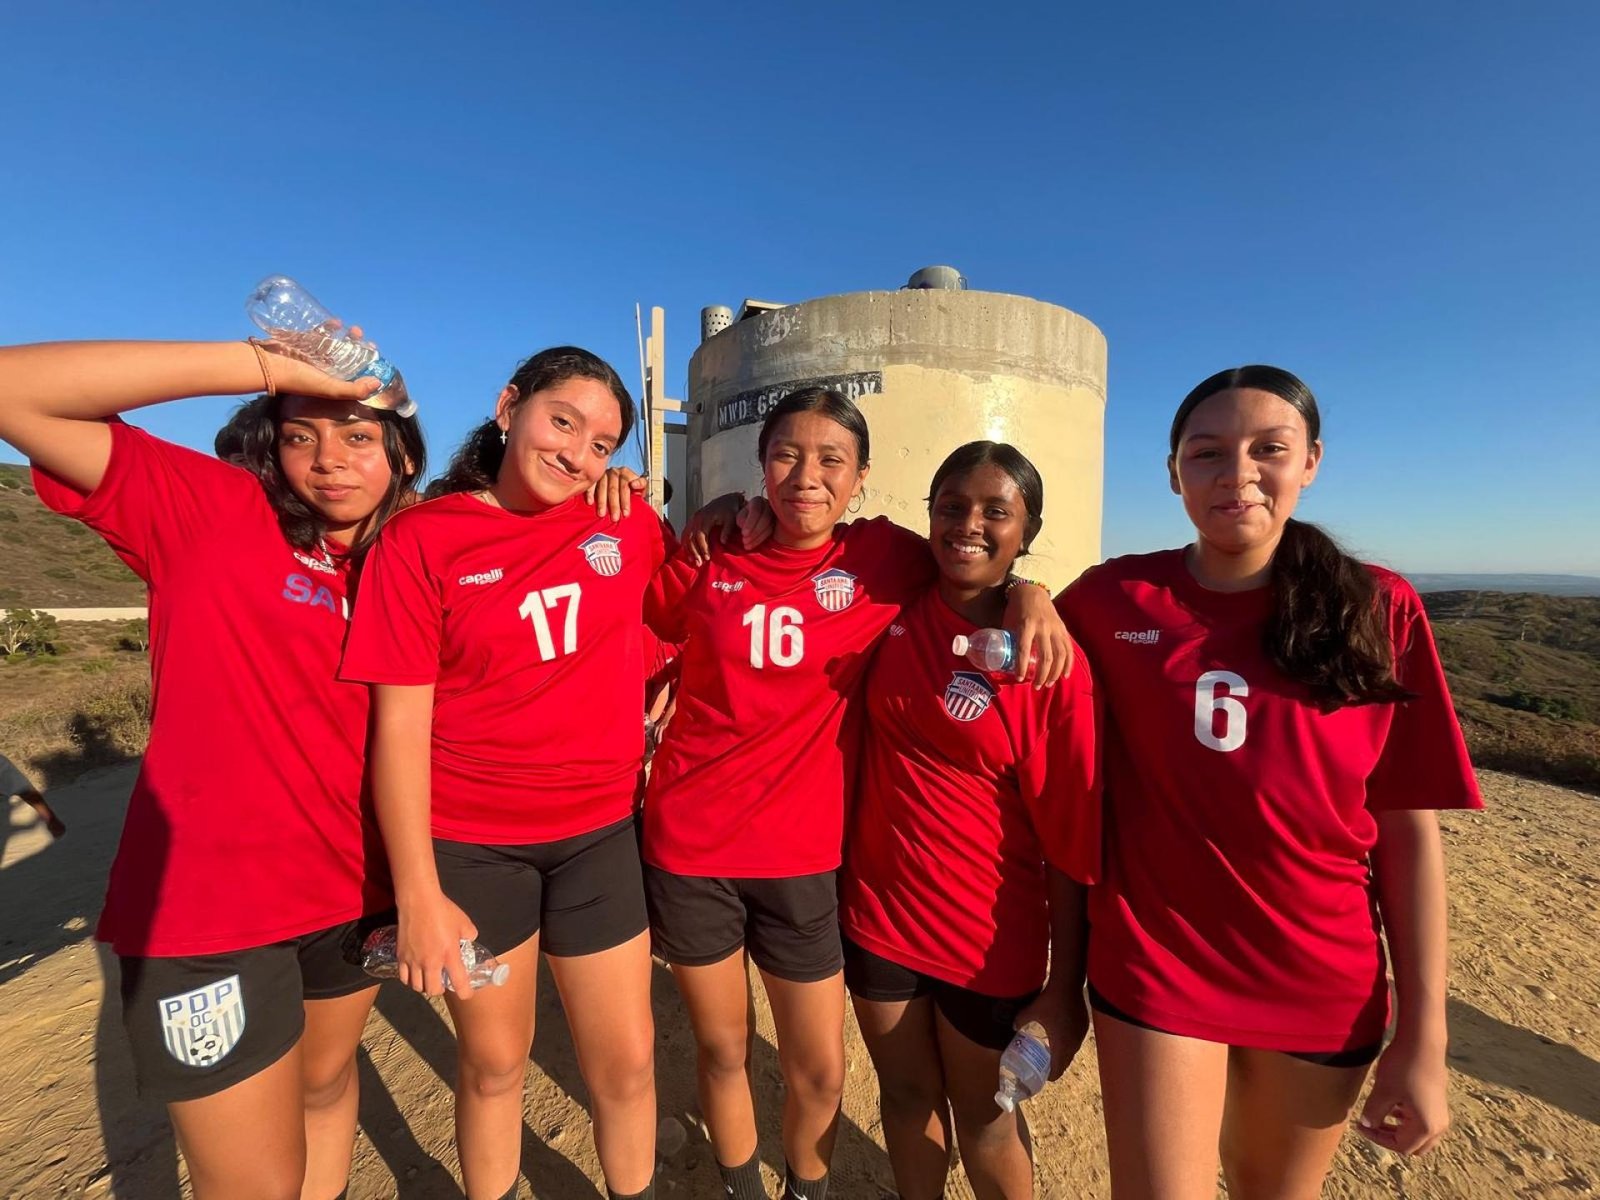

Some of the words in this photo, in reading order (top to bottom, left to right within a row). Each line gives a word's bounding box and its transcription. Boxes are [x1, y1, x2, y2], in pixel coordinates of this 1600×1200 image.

[719, 400, 747, 426] MWD
[458, 567, 503, 586] capelli
[518, 582, 582, 662] 17
[742, 603, 805, 669] 16
[1114, 629, 1160, 643] capelli
[1194, 669, 1249, 753] 6
[190, 1010, 213, 1028] OC
